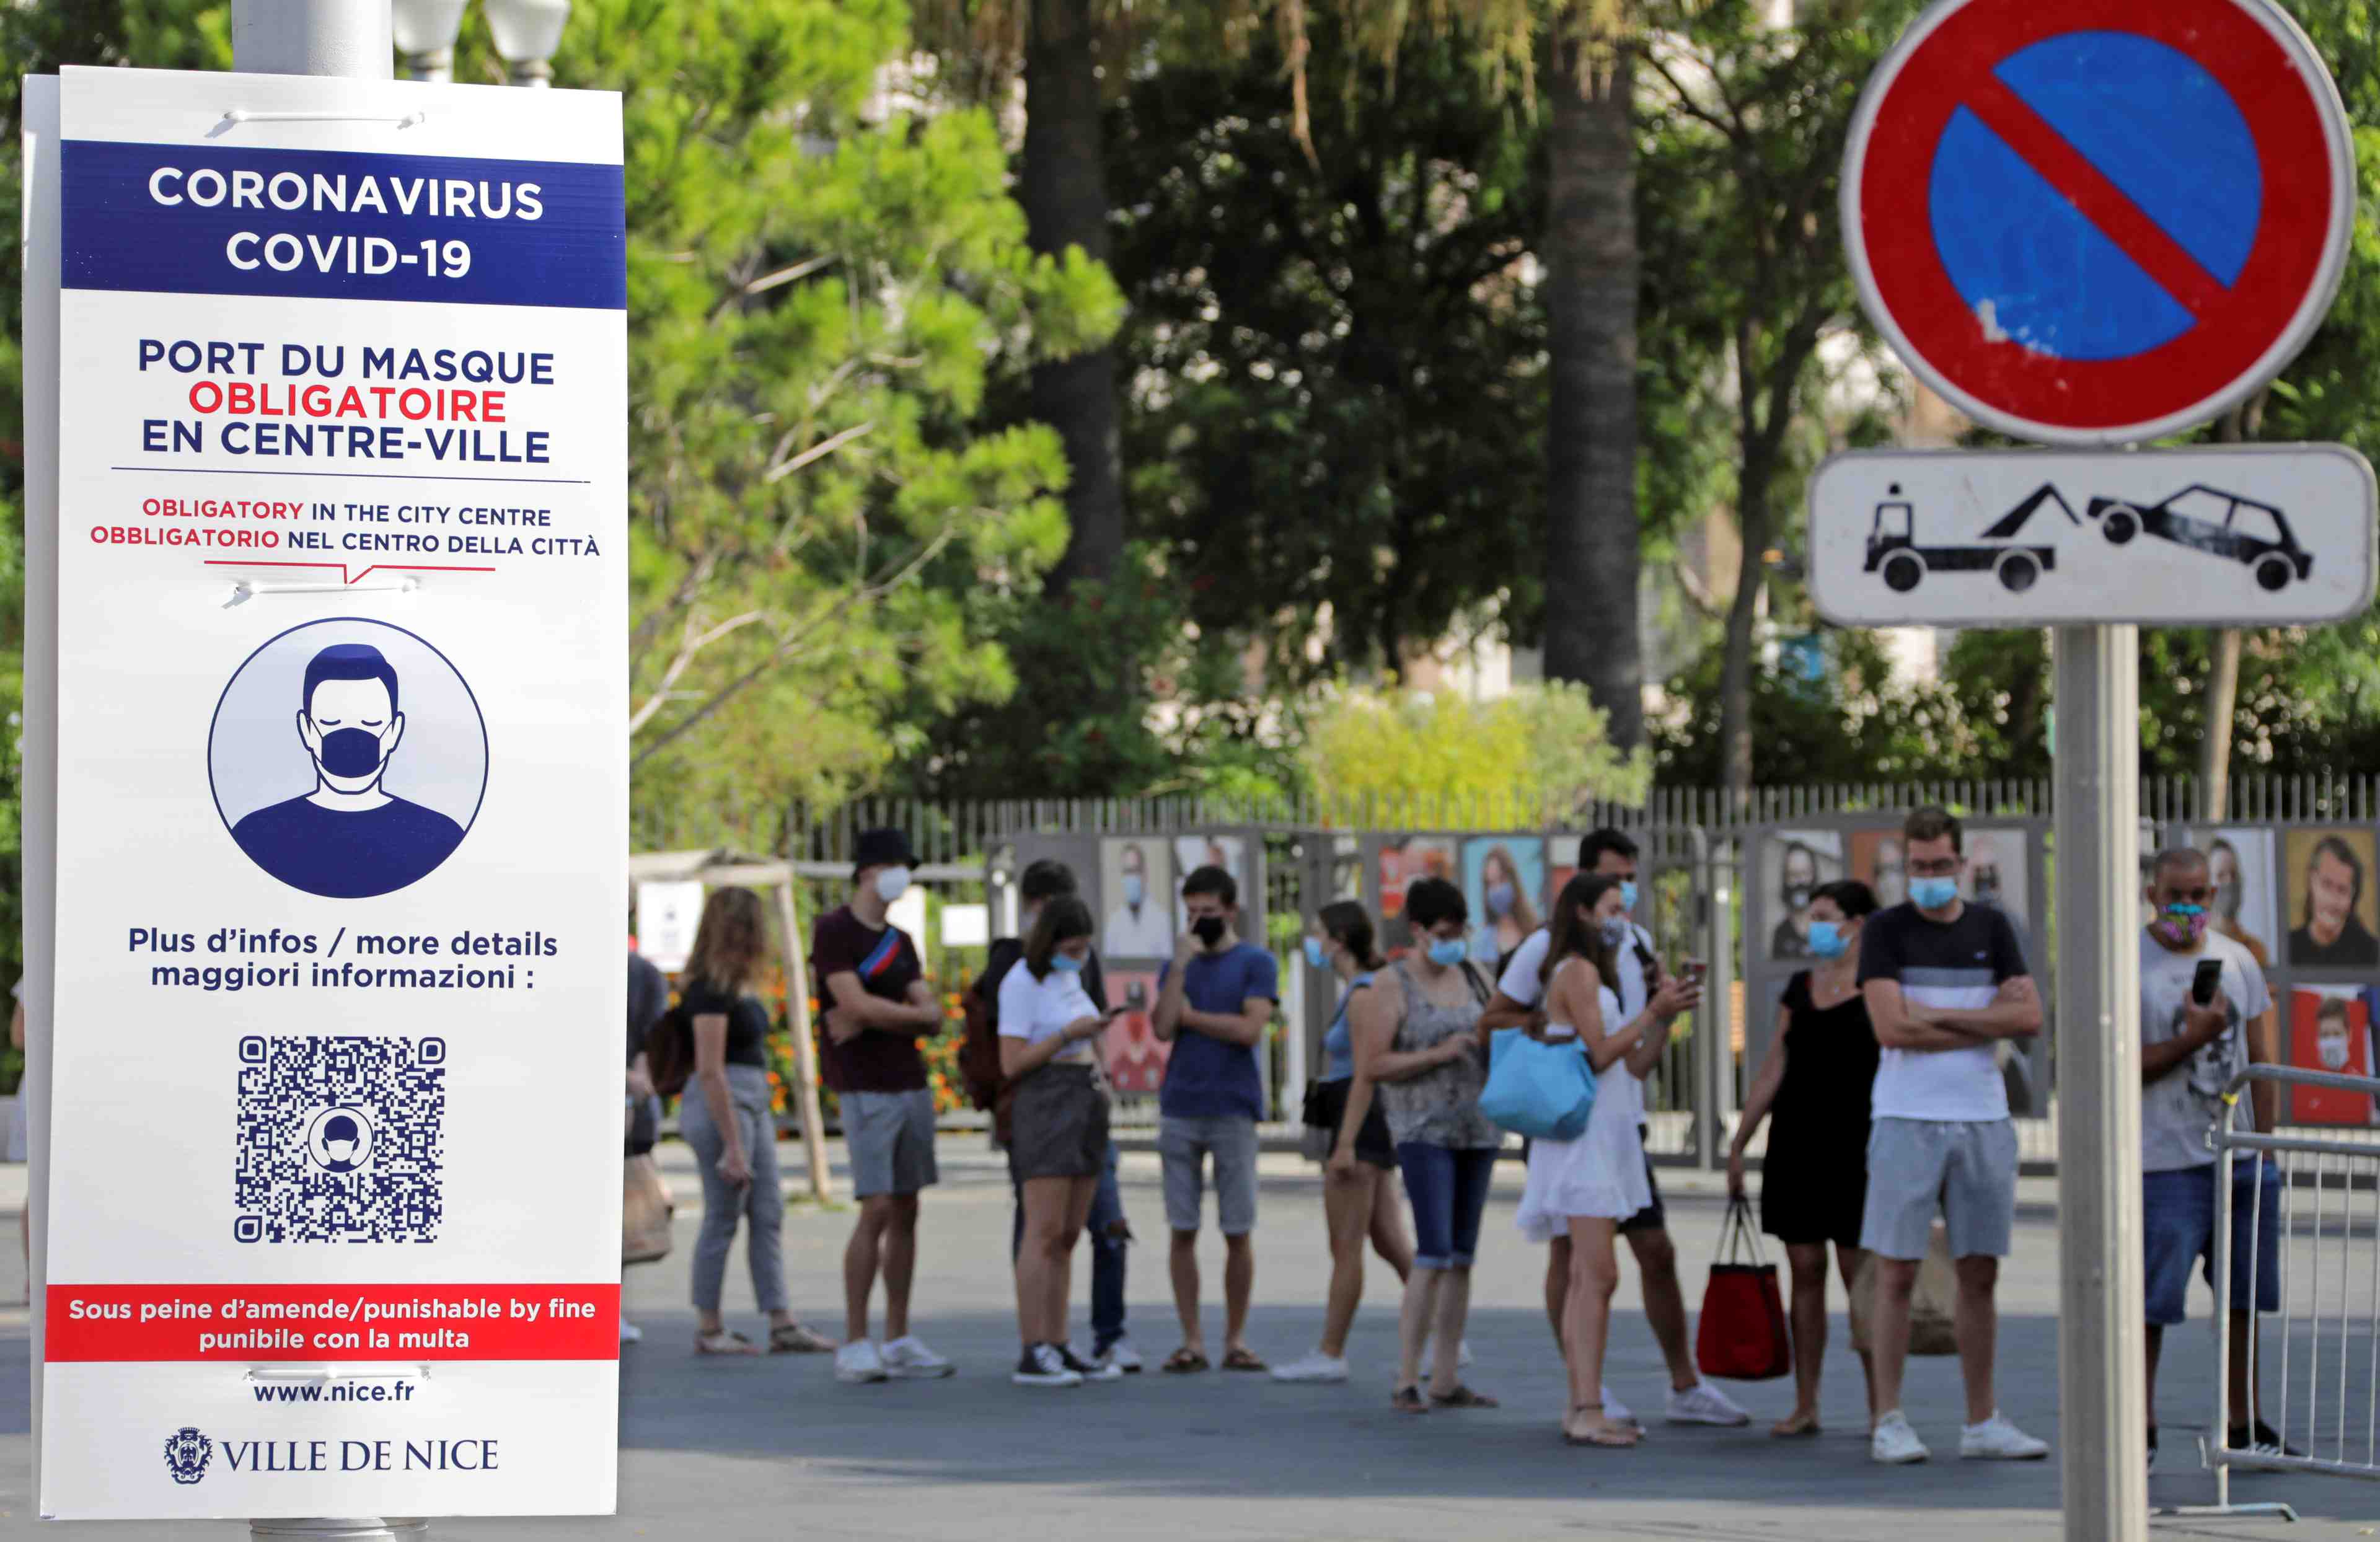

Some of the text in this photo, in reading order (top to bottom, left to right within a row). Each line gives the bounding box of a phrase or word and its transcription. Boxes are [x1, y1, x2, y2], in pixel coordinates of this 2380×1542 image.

[149, 167, 543, 220] CORONAVIRUS
[227, 232, 470, 278] COVID-19
[139, 340, 553, 384] PORT DU MASQUE
[190, 381, 505, 422] OBLIGATOIRE
[144, 420, 549, 463] EN CENTRE-VILLE
[143, 499, 550, 526] OBLIGATORY IN THE CITY CENTRE
[91, 526, 599, 555] OBBLIGATORIO NEL CENTRO DELLA CITTÀ
[130, 928, 195, 952] Plus
[208, 928, 317, 953] d’infos
[357, 936, 438, 954] more
[451, 931, 557, 956] details
[152, 962, 298, 991] maggiori
[312, 963, 514, 988] informazioni
[69, 1300, 131, 1318] Sous
[141, 1299, 211, 1322] peine
[511, 1298, 540, 1321] by
[549, 1298, 595, 1318] fine
[200, 1329, 469, 1352] punibile con la multa
[254, 1381, 413, 1401] www.nice.fr
[220, 1440, 497, 1471] VILLE DE NICE
